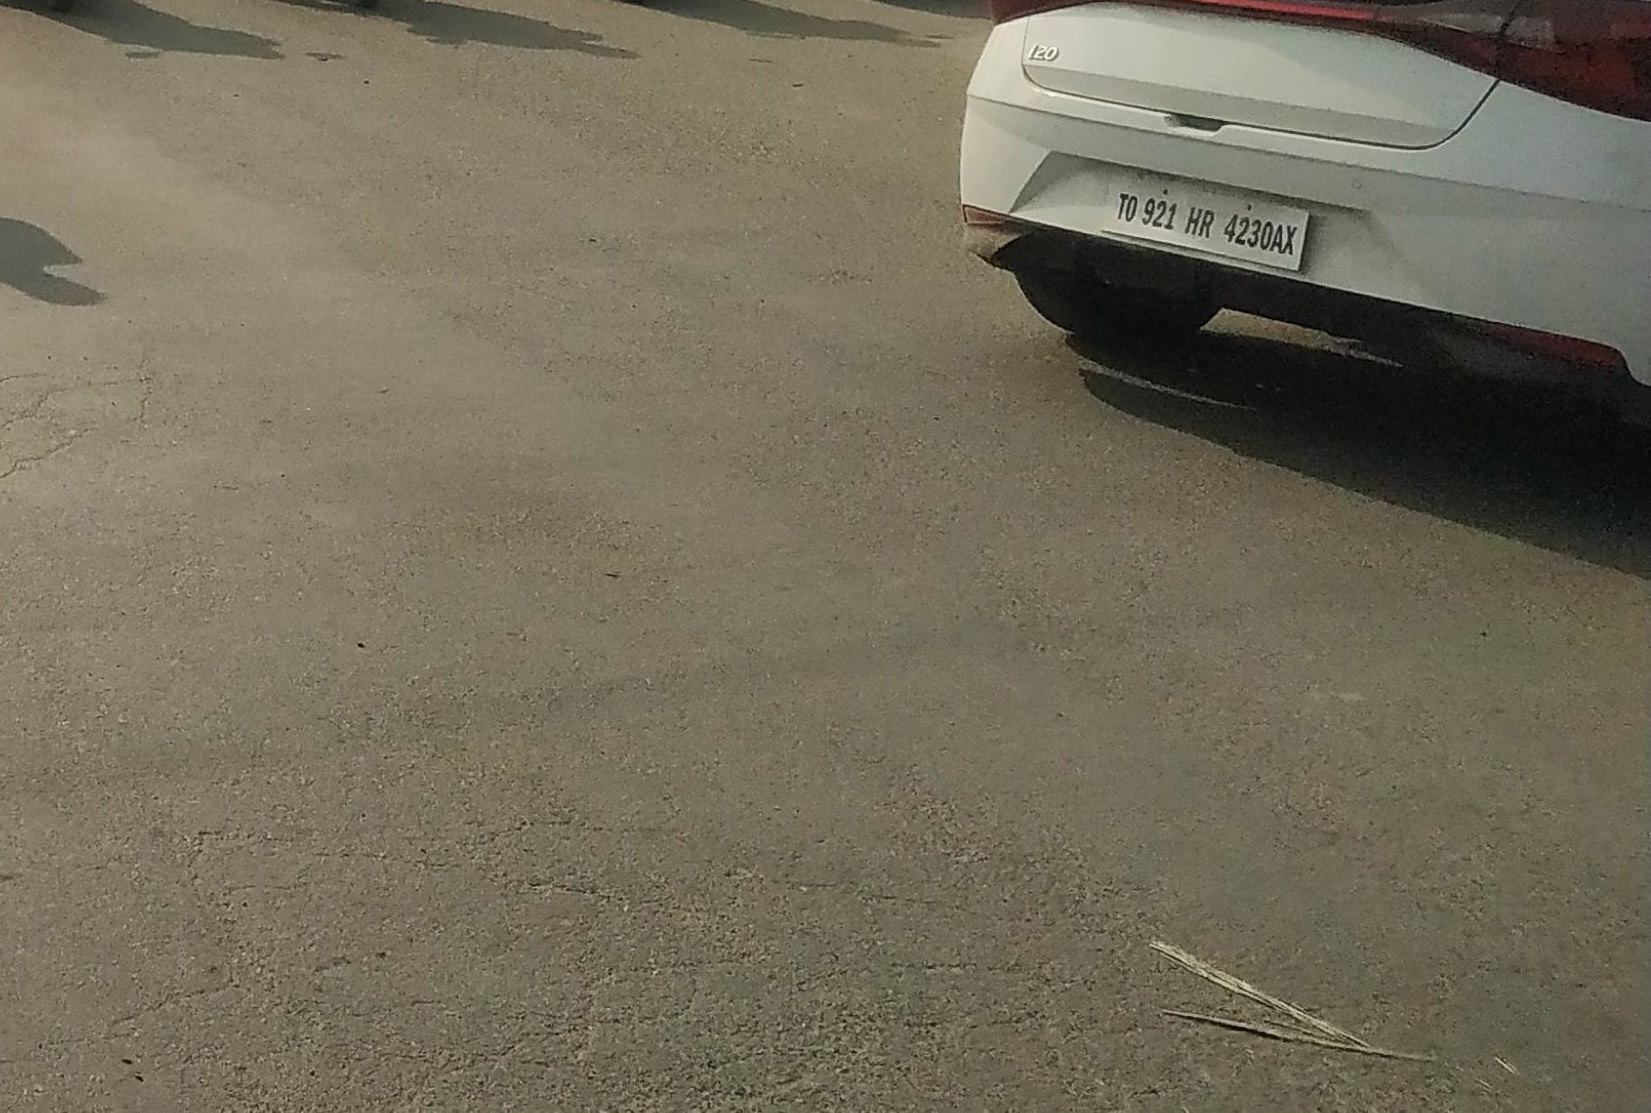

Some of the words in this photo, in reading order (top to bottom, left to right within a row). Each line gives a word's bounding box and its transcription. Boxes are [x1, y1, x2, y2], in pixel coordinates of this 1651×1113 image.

[1142, 198, 1177, 231] 921
[1185, 207, 1215, 238] HR
[1224, 214, 1297, 256] 4230AX
